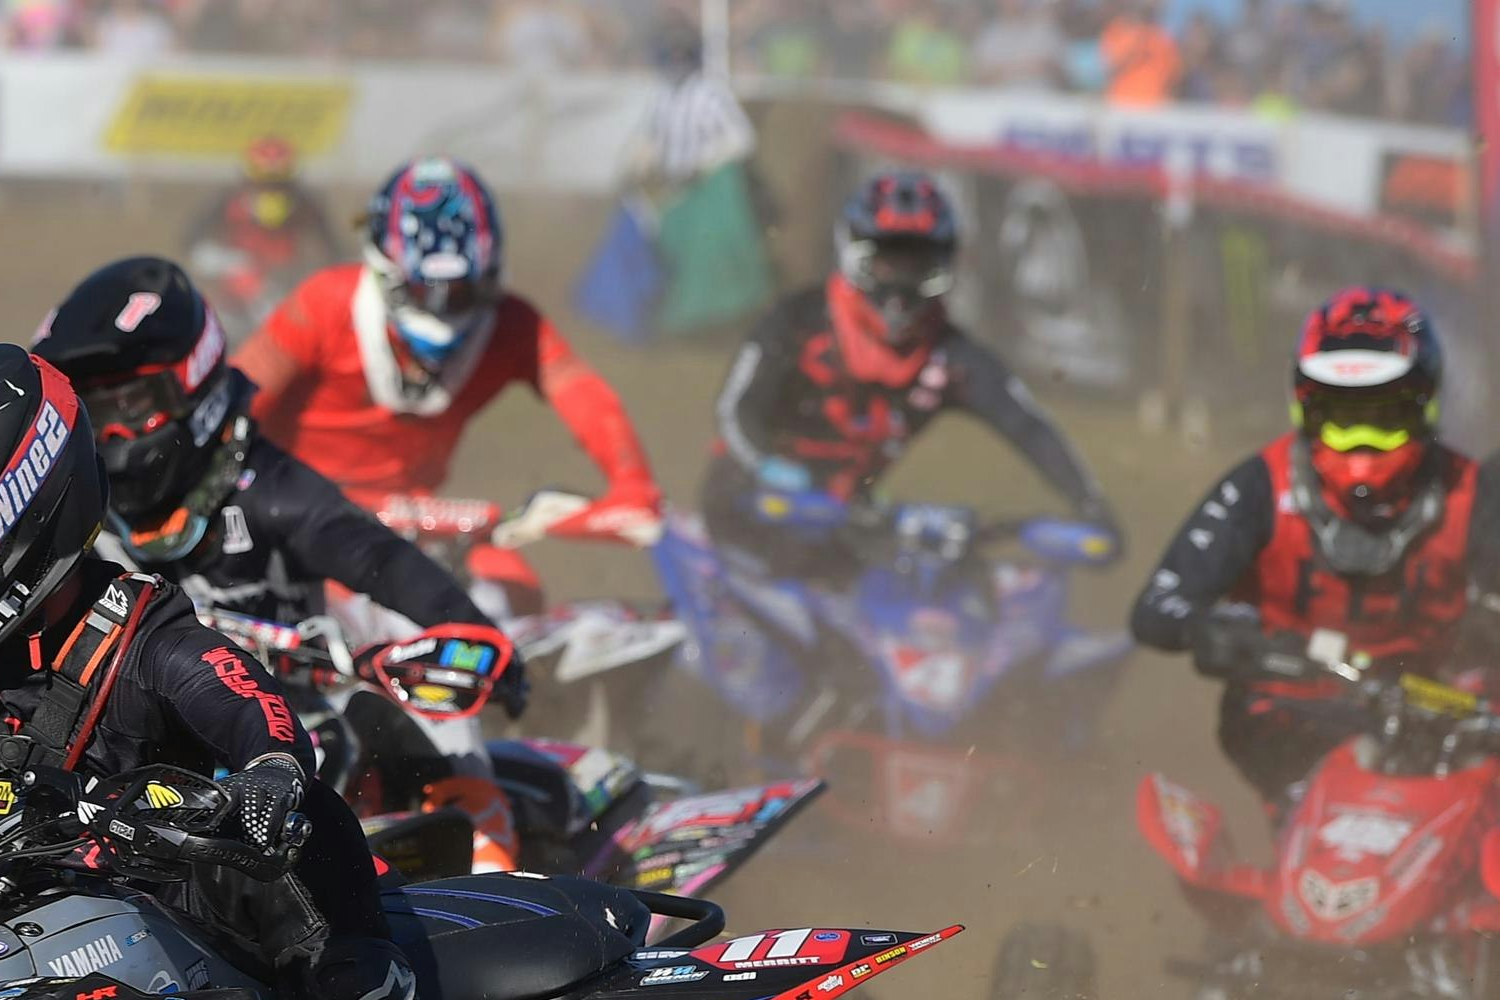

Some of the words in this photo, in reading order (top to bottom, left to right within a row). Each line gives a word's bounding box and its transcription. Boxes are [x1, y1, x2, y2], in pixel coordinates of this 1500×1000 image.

[48, 934, 124, 978] YAMAHA
[719, 930, 811, 962] 11
[735, 956, 821, 969] MERRITT
